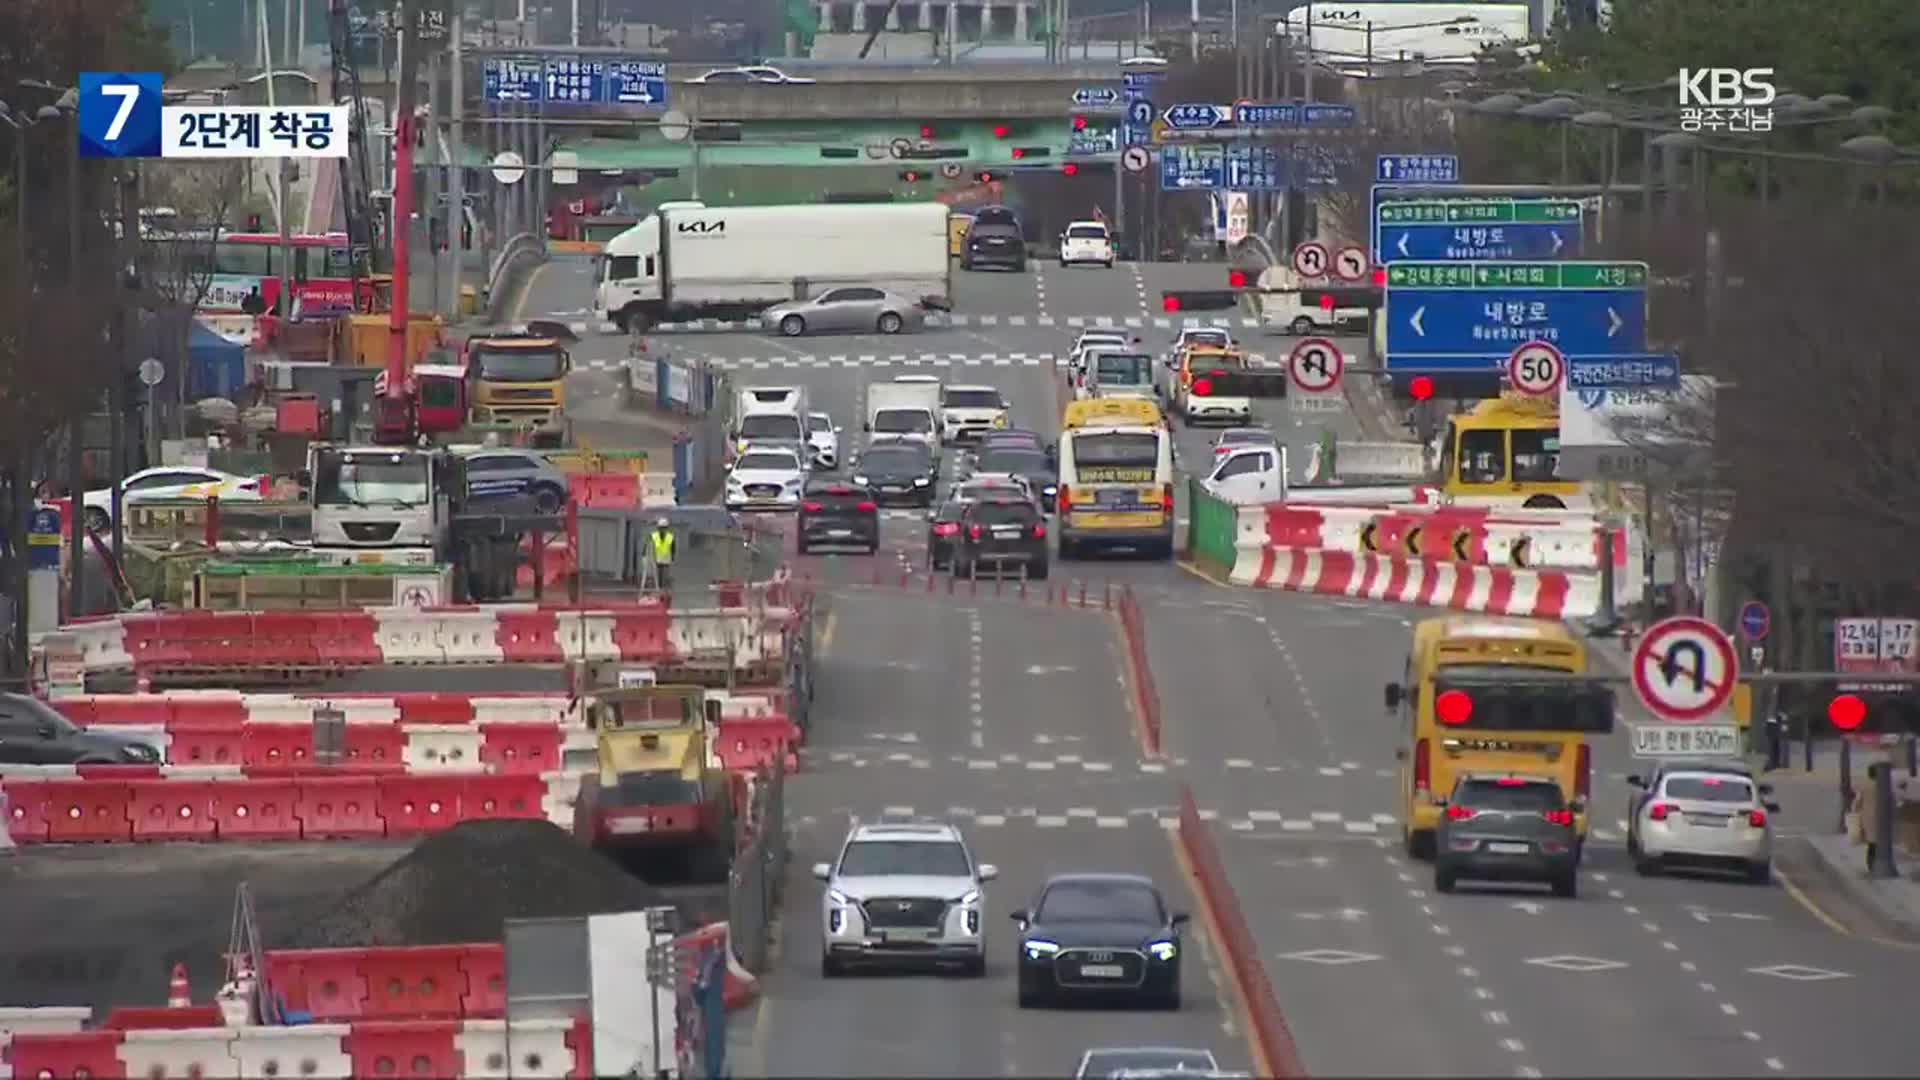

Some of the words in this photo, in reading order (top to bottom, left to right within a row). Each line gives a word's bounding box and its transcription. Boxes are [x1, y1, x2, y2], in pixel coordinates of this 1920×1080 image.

[1321, 10, 1361, 20] KIA
[679, 220, 726, 233] KIA
[1455, 228, 1505, 245] 내방로
[1499, 267, 1545, 283] 시의회
[1595, 267, 1625, 286] 시청
[1484, 300, 1549, 326] 내방로
[1521, 357, 1553, 382] 50
